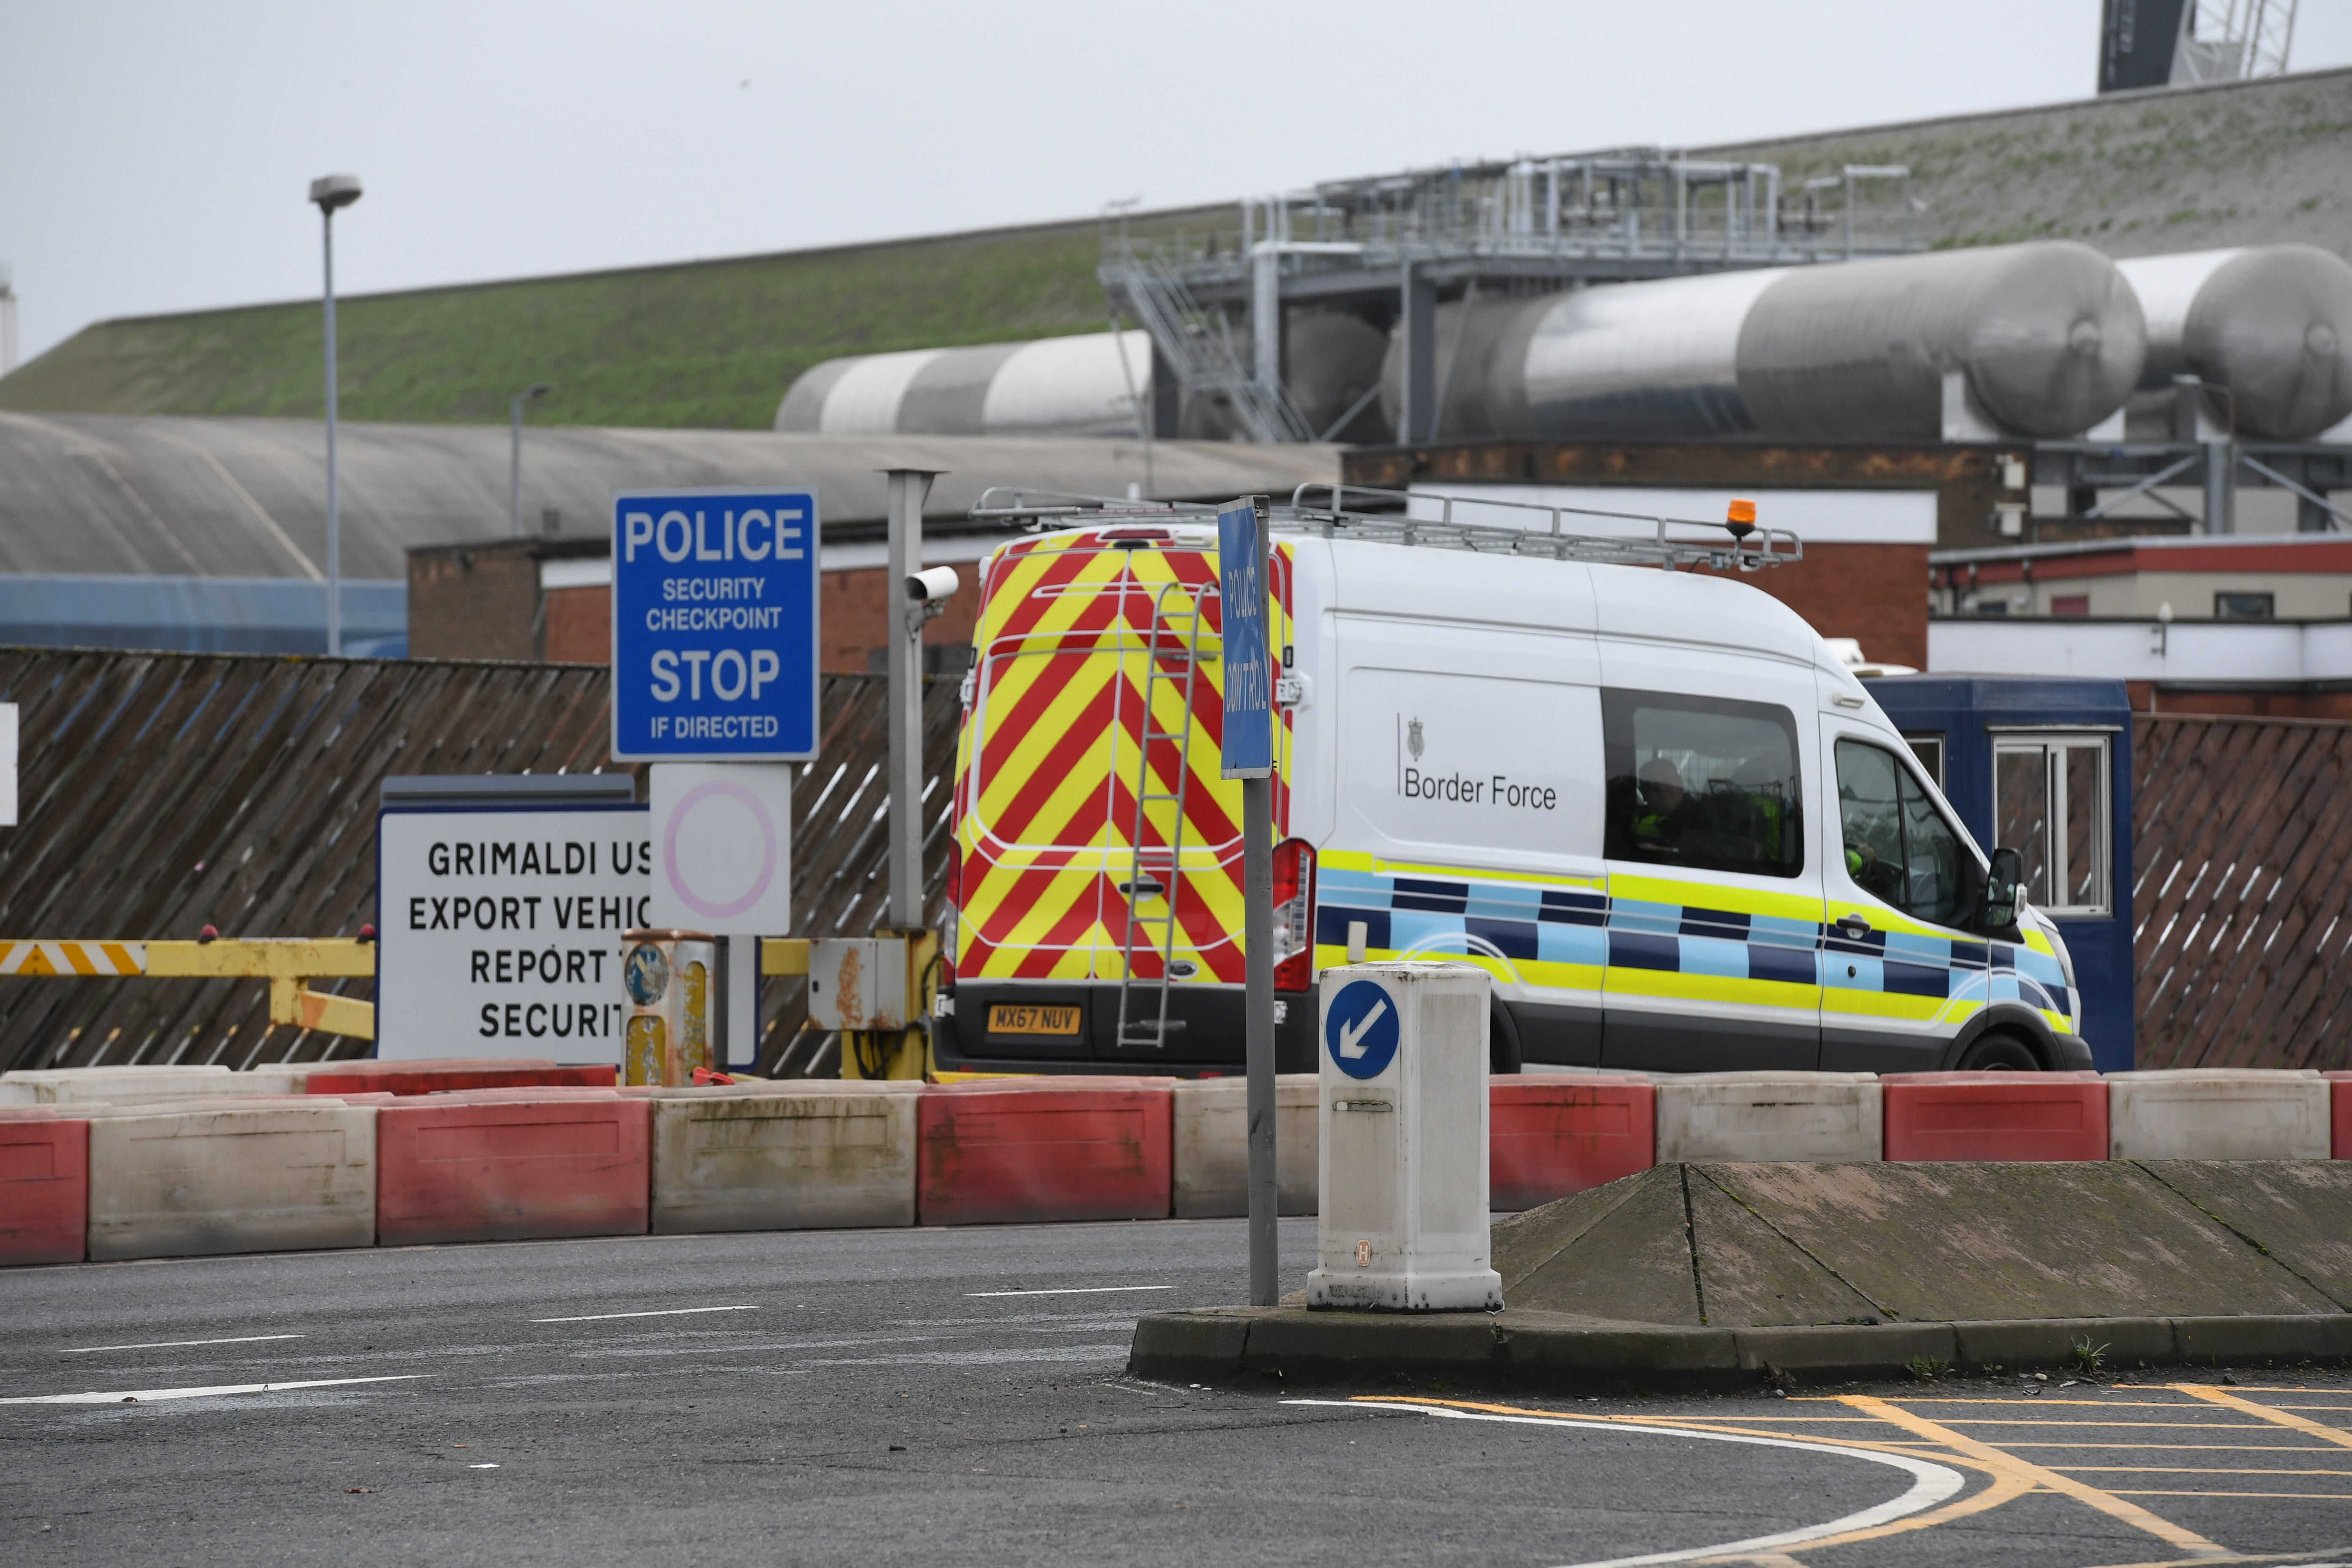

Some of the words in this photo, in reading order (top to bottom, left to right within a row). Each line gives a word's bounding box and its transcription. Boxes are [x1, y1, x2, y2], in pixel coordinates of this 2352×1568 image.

[625, 509, 804, 563] POLICE
[663, 577, 765, 601] SECURITY
[1228, 566, 1257, 619] POLICE
[646, 607, 782, 631] CHECKPOINT
[650, 648, 780, 702] STOP
[1226, 660, 1266, 713] CONTROL
[651, 716, 669, 738] IF
[675, 716, 778, 738] DIRECTED
[1405, 768, 1484, 803] Border
[1492, 776, 1556, 810] Force
[428, 841, 596, 876] GRIMALDI
[410, 896, 541, 930] EXPORT
[471, 949, 607, 983] REPORT
[996, 1007, 1037, 1028] MX67
[1041, 1008, 1073, 1029] NUV
[1358, 1245, 1368, 1261] H
